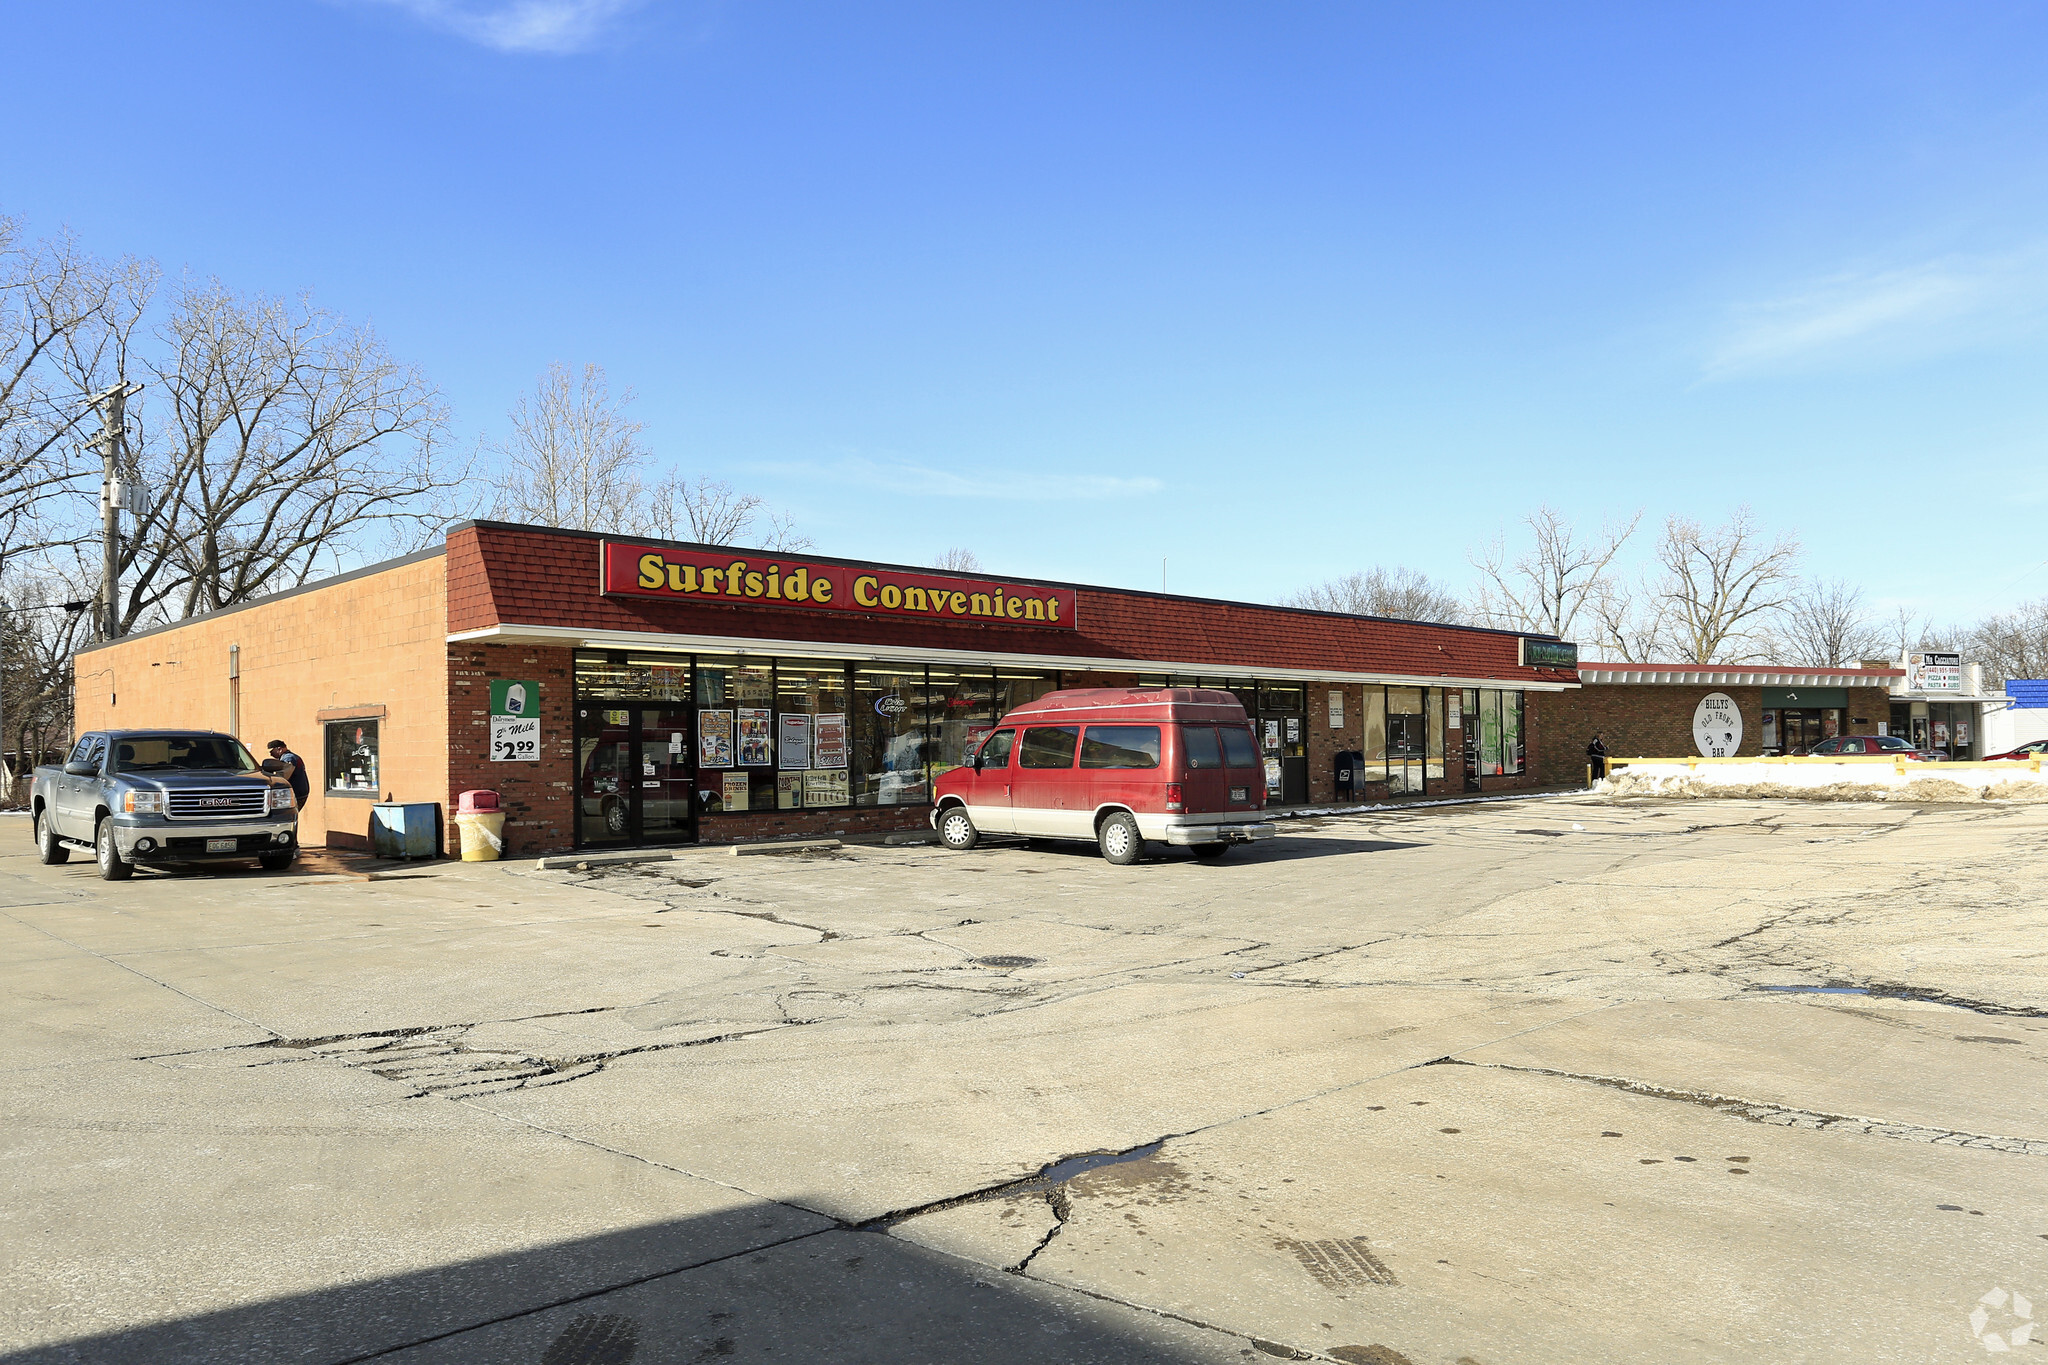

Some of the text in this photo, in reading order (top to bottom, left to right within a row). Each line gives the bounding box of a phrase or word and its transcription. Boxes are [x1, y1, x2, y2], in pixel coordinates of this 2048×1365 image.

[637, 553, 1061, 623] Surfside Convenient
[1701, 711, 1734, 728] OLD FRONT
[508, 721, 535, 735] Milk
[1712, 747, 1725, 758] BAR
[200, 797, 240, 807] GMC
